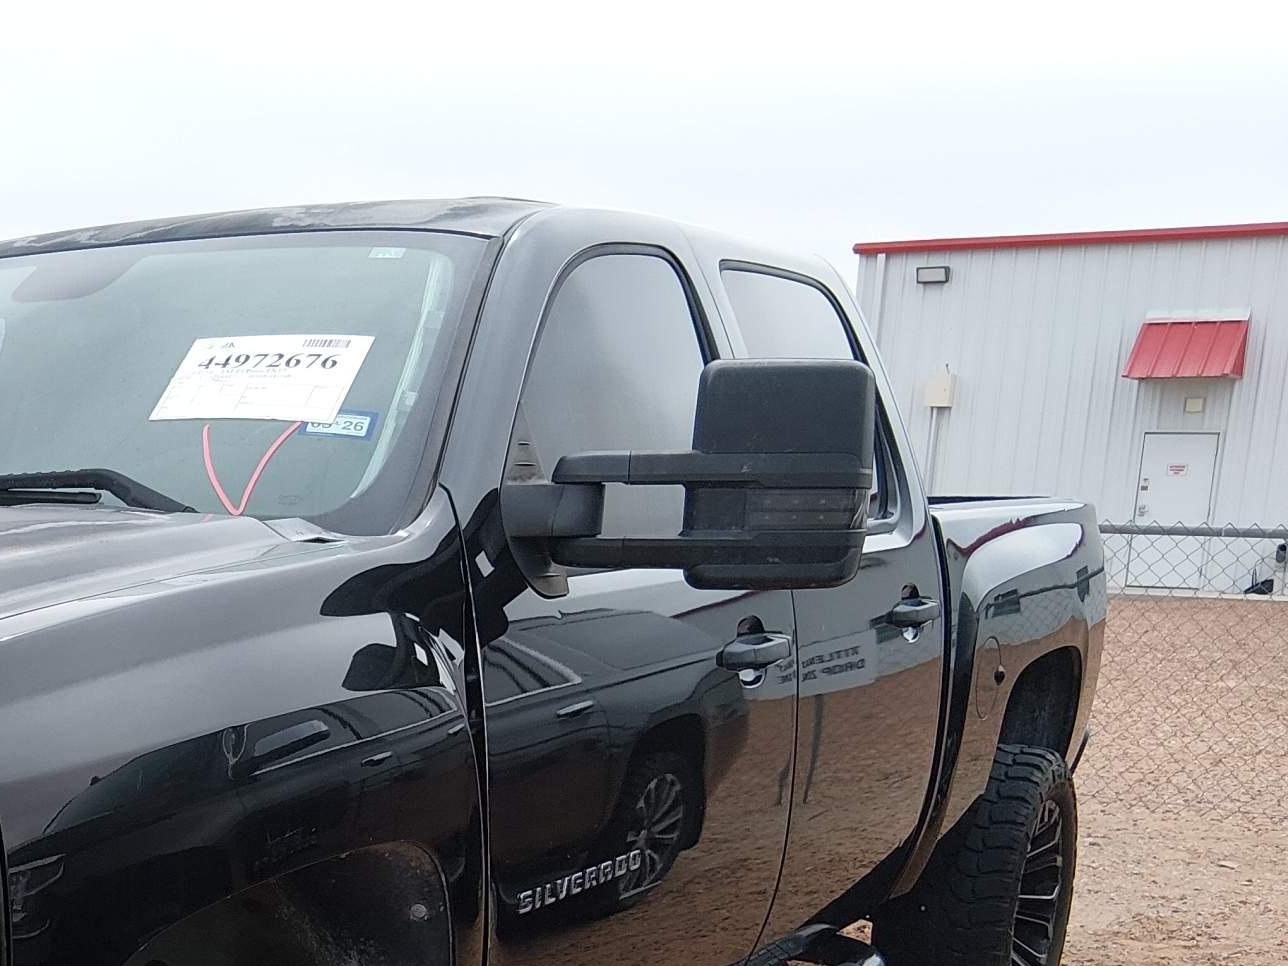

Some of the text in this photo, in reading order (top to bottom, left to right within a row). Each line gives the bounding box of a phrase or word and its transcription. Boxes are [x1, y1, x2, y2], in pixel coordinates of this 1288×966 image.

[198, 353, 338, 370] 44972676
[341, 420, 365, 432] 26
[516, 849, 641, 914] SILVERADO
